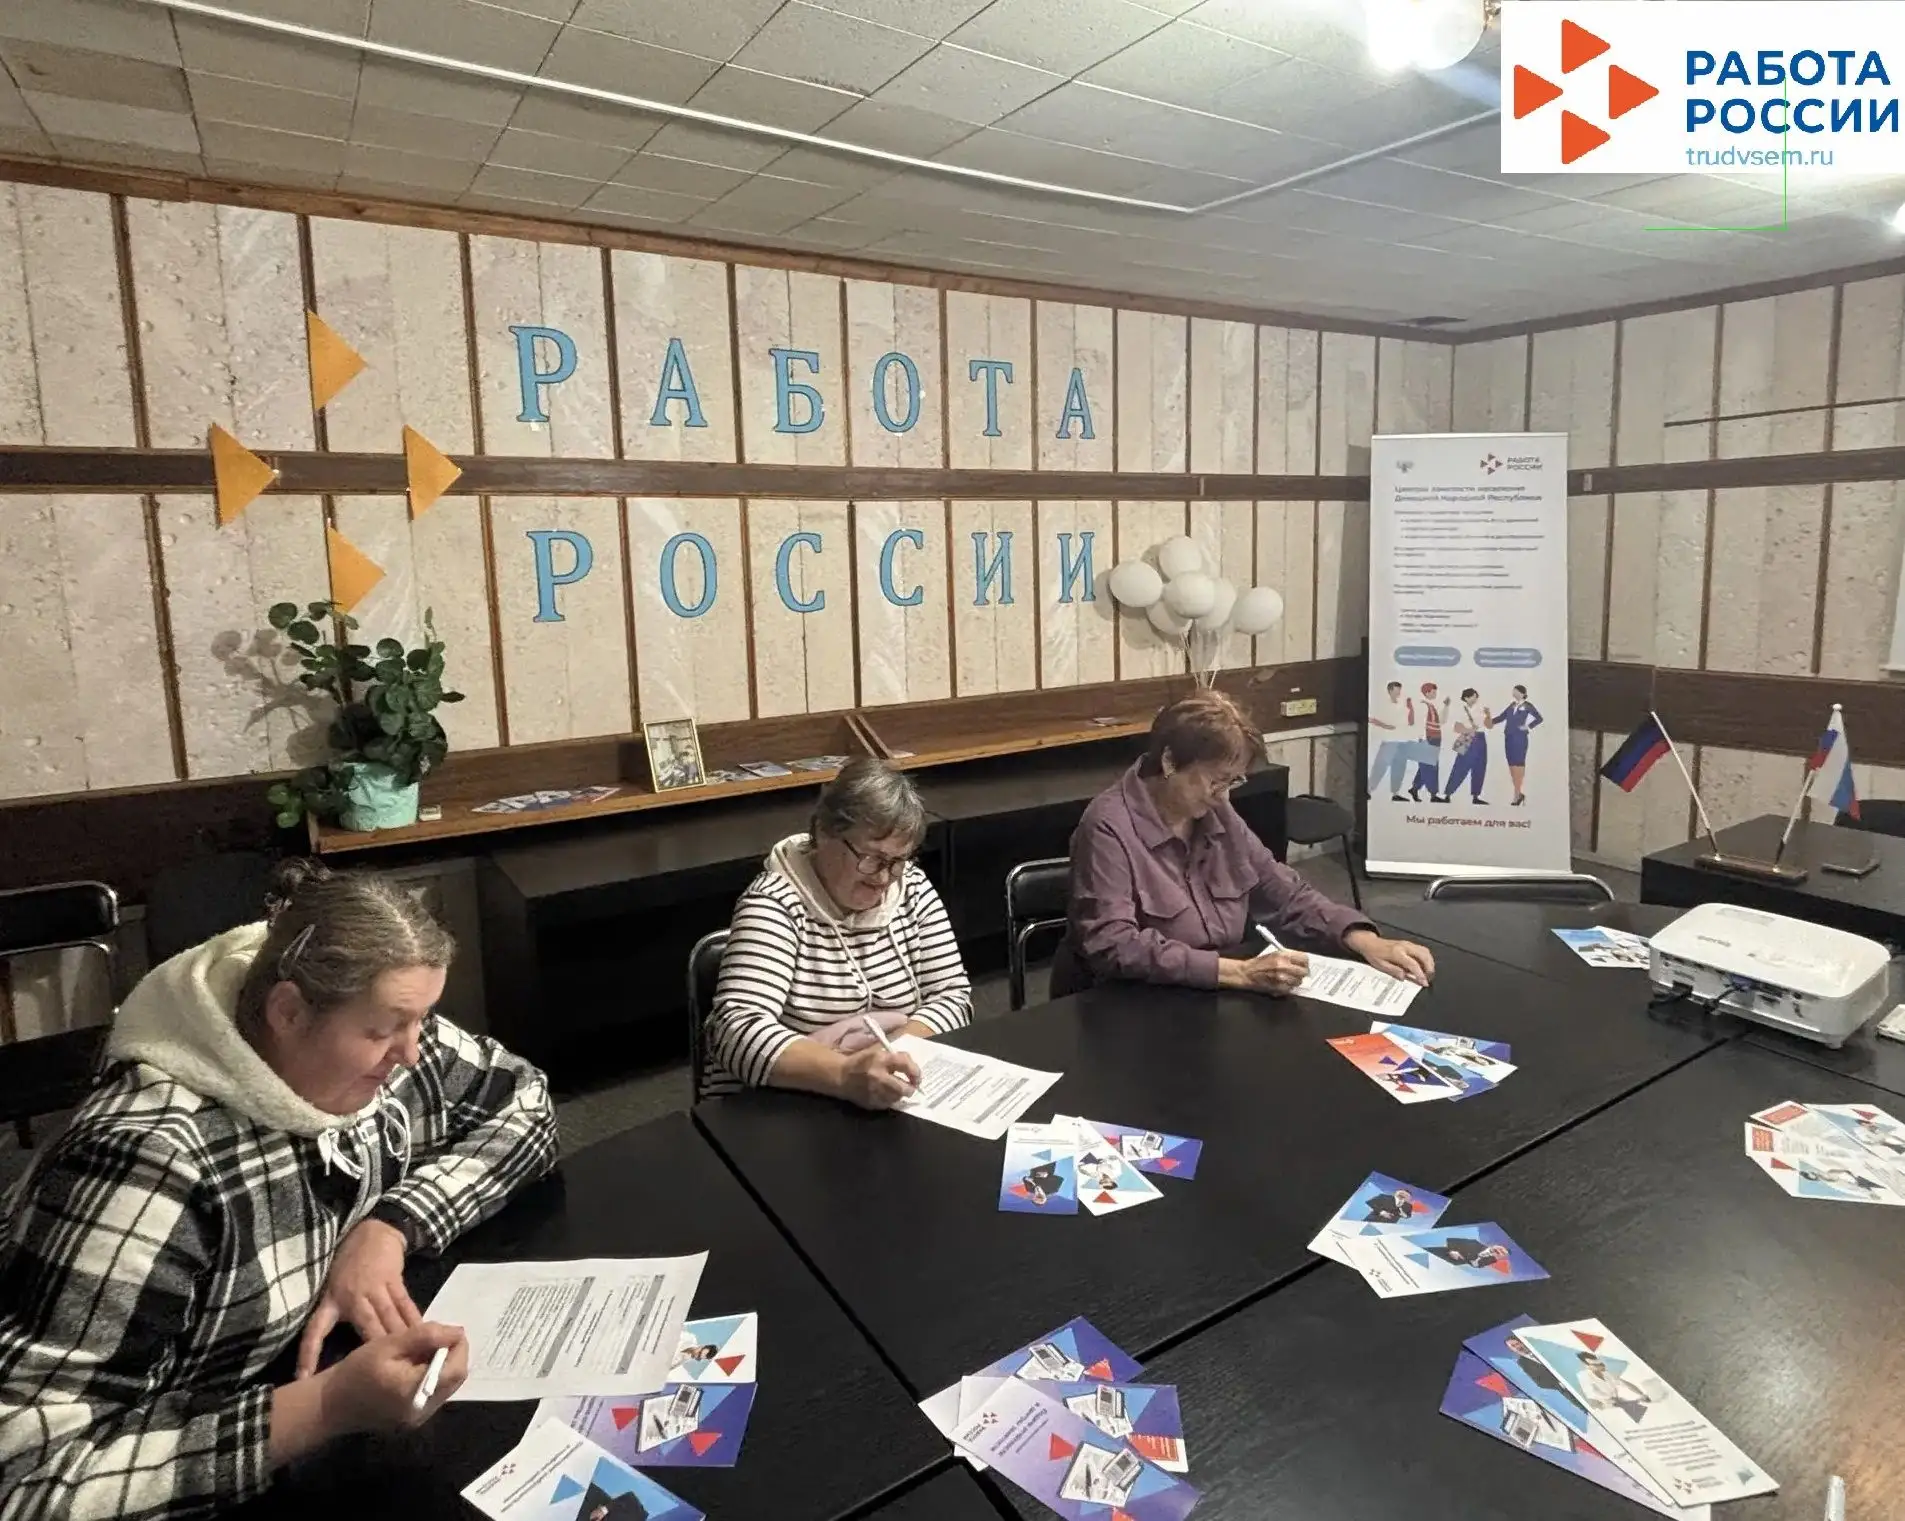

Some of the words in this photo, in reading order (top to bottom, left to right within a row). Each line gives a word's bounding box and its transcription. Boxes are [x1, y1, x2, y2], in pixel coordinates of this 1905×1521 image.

[508, 325, 1096, 440] РАБОТА
[526, 529, 1096, 623] РОССИИ
[1406, 815, 1425, 824] Мы
[1427, 816, 1482, 827] работаем
[1483, 819, 1506, 829] для
[1508, 819, 1532, 829] вас!
